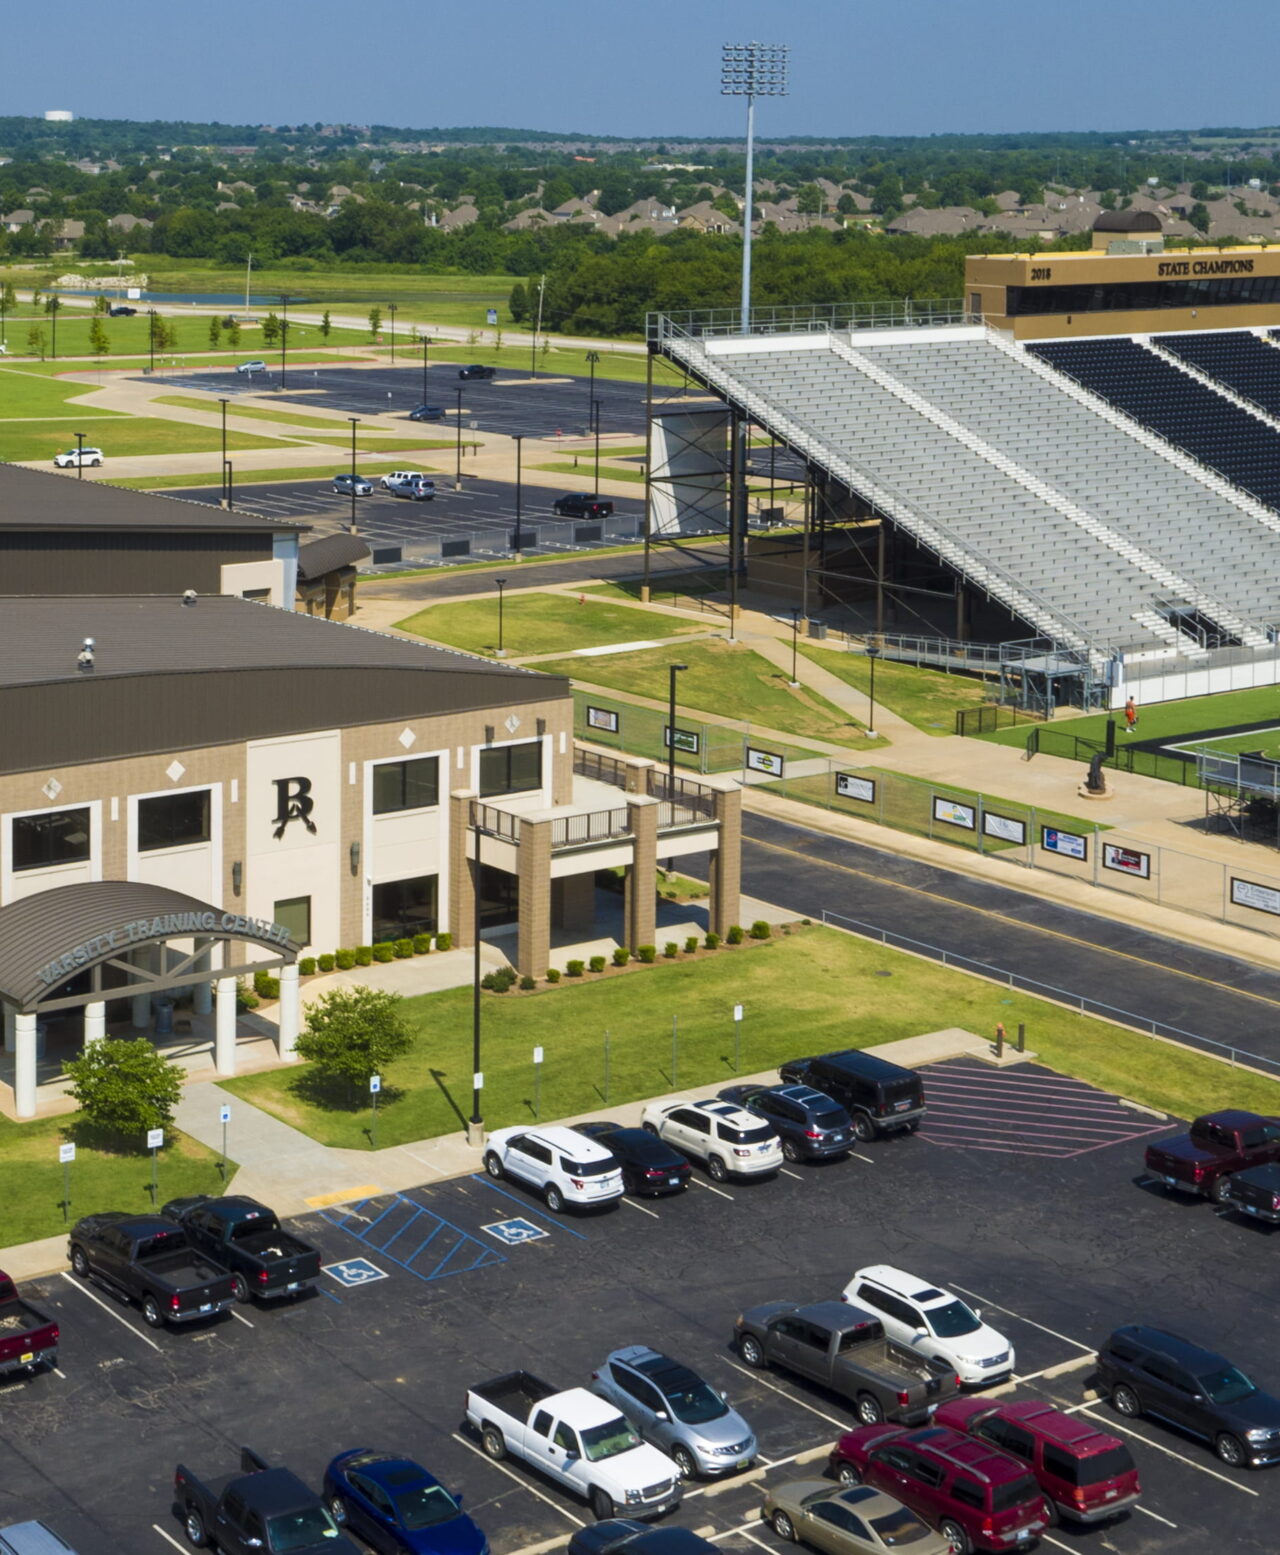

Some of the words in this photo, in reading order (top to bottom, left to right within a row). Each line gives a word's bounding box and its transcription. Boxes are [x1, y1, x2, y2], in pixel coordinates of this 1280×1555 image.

[1158, 262, 1190, 276] STATE
[1192, 259, 1254, 275] CHAMPIONS
[36, 929, 120, 986] VARSITY
[123, 911, 216, 944] TRAINING
[220, 912, 292, 947] CENTER
